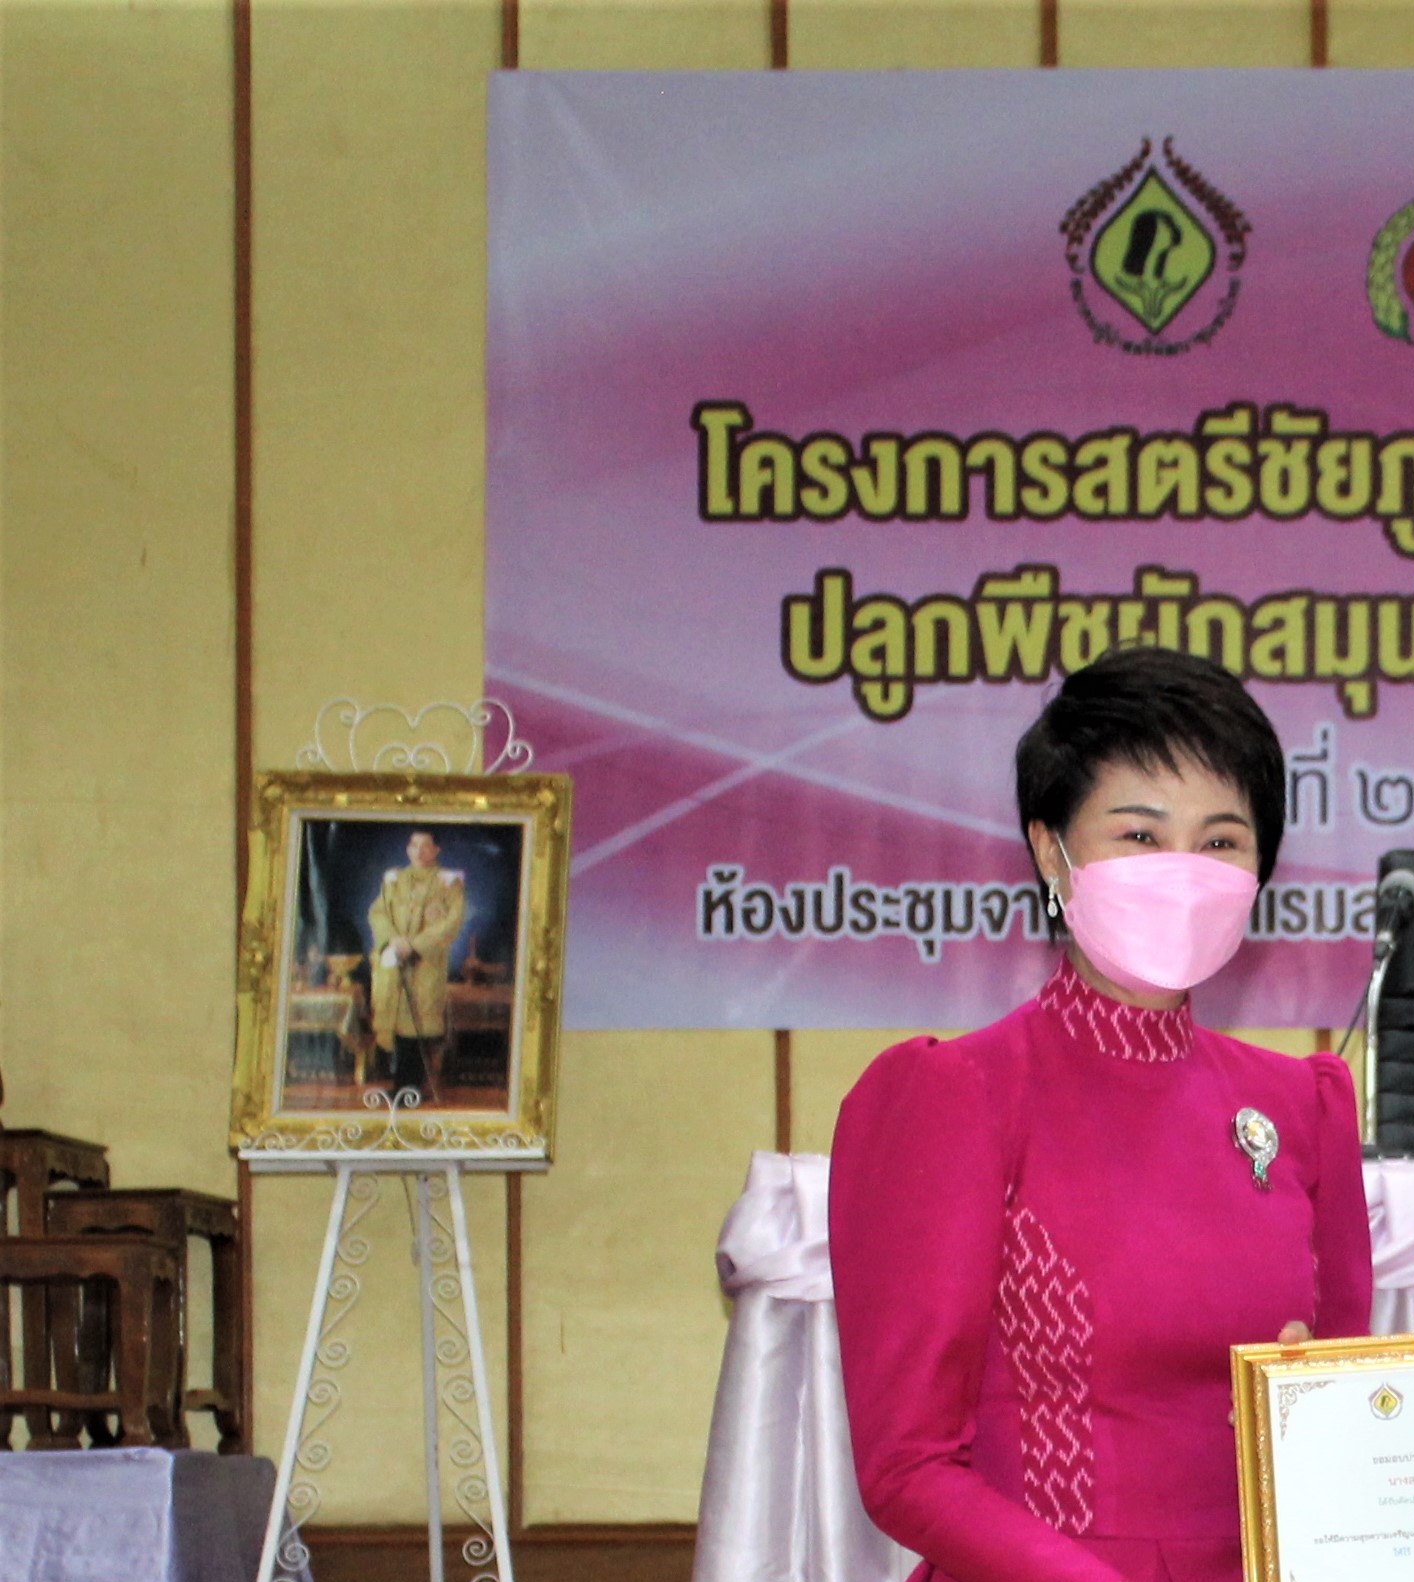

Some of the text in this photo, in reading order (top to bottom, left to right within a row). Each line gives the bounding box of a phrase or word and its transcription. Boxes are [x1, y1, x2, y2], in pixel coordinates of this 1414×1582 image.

[1289, 727, 1329, 826] ที่
[700, 872, 1040, 958] ห้องประชุมจา
